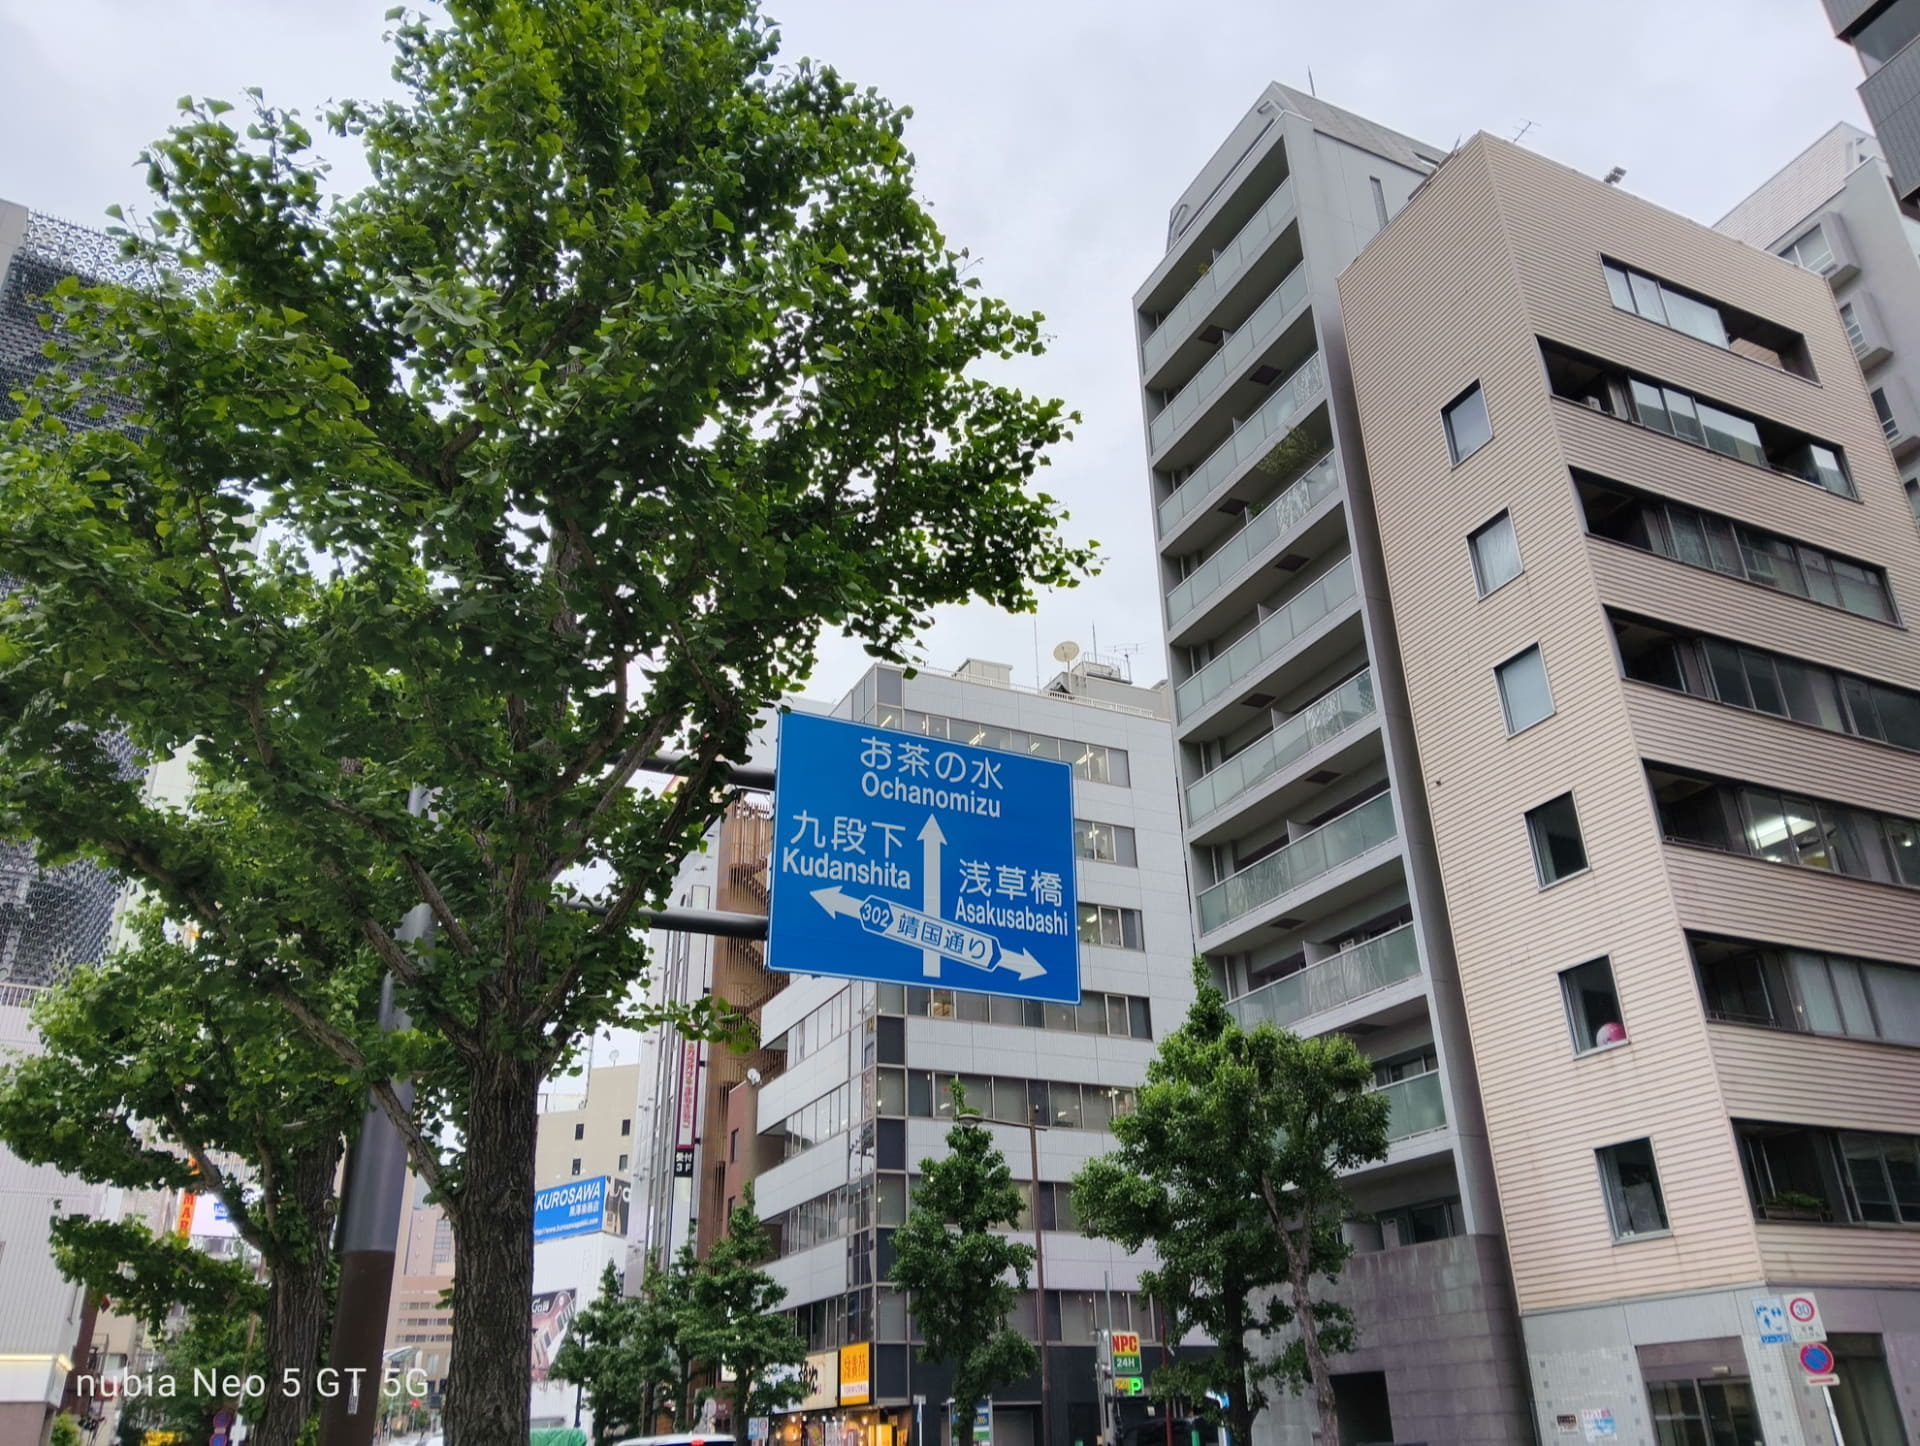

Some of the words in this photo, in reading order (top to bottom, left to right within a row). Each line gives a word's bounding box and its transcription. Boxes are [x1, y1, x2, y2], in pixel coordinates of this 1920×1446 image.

[860, 736, 1004, 790] お茶の水
[861, 771, 1001, 818] Ochanomizu
[790, 809, 906, 859] 九段下
[782, 847, 911, 890] Kudanshita
[959, 858, 1063, 908] 浅草橋
[863, 905, 891, 929] 302
[896, 912, 987, 960] 靖国通り
[955, 896, 1069, 937] Asakusabashi
[535, 1181, 600, 1212] KUROSAWA
[1795, 1304, 1810, 1316] 30
[1112, 1335, 1137, 1352] NPC
[1116, 1357, 1135, 1368] 24H
